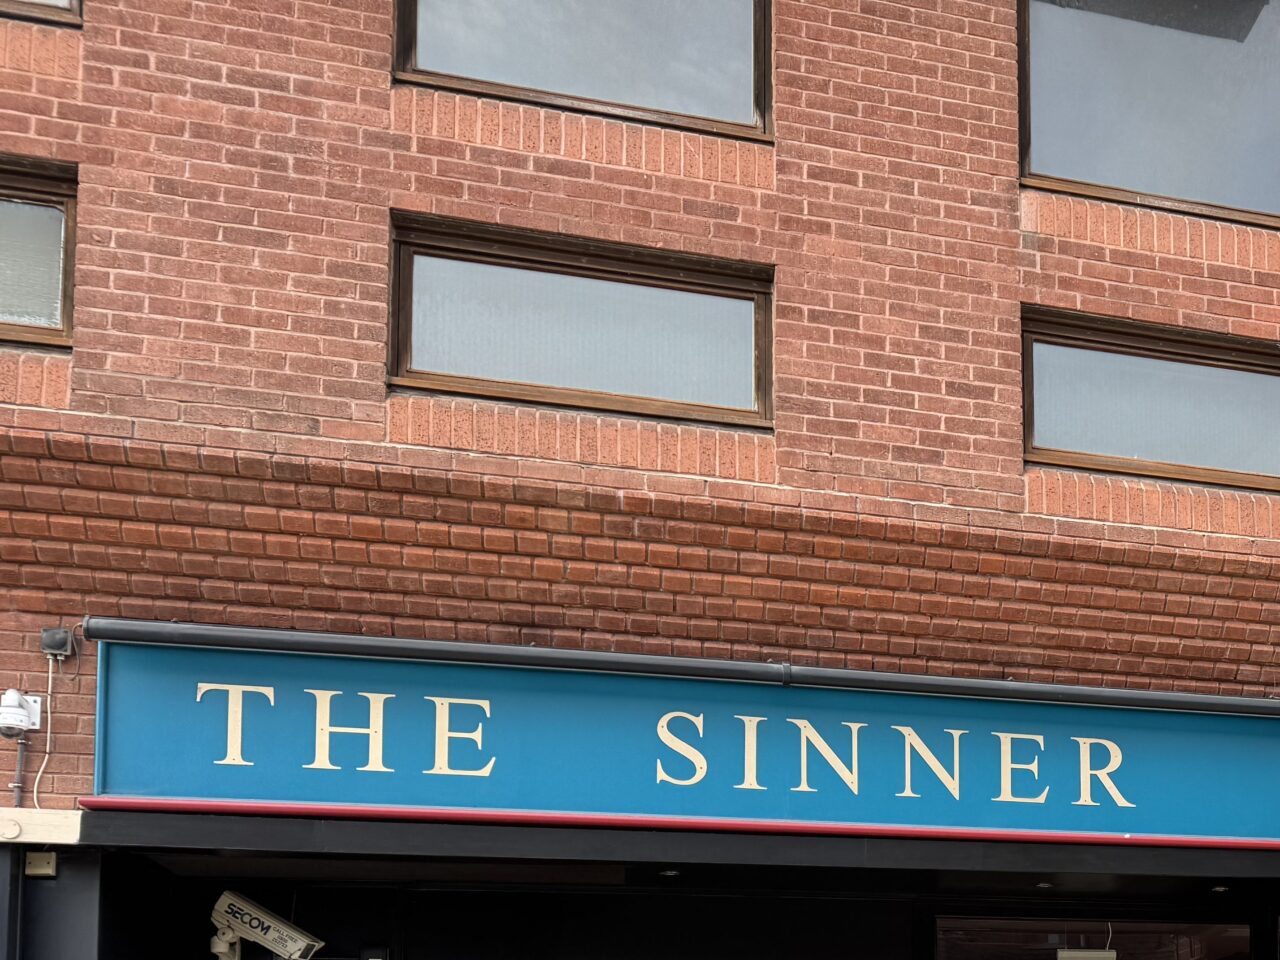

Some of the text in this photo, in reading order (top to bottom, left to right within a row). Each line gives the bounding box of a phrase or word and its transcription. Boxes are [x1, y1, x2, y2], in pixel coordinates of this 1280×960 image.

[195, 682, 1136, 809] THE SINNER
[224, 903, 271, 936] SECOM
[272, 926, 286, 938] CALL
